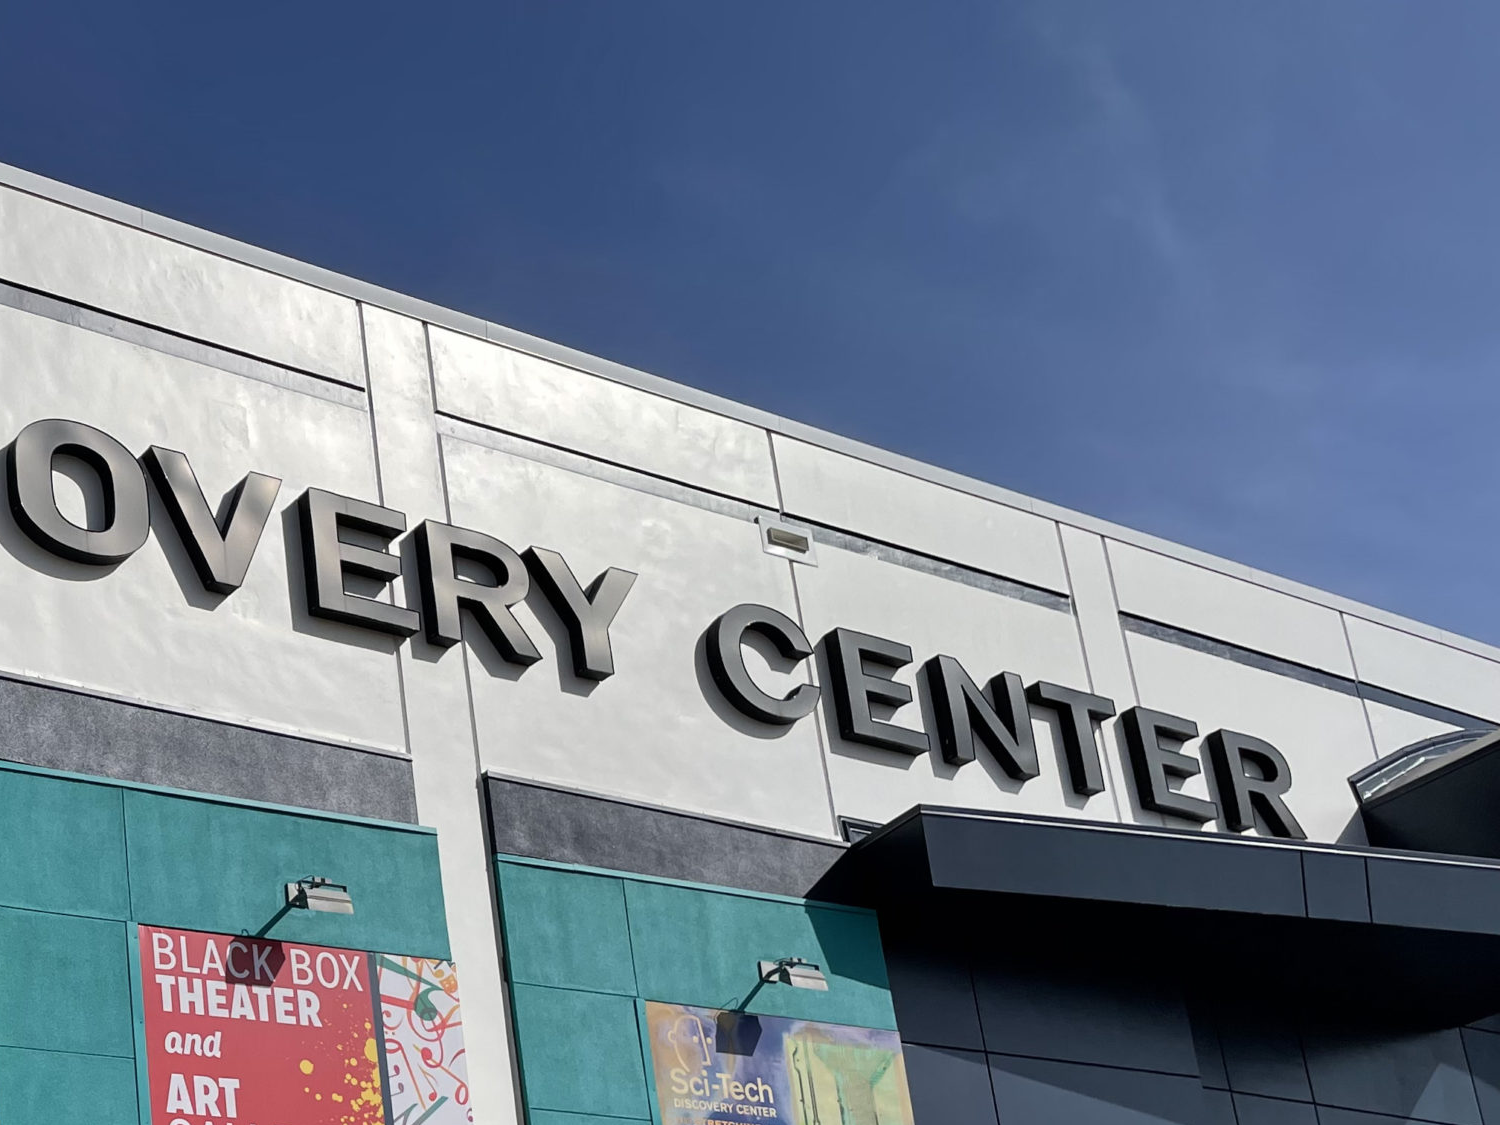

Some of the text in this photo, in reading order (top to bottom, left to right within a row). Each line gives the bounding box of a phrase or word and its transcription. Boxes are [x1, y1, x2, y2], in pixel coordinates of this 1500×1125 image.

[697, 603, 1307, 840] CENTER
[152, 932, 364, 992] BLACK BOX
[155, 974, 323, 1028] THEATER
[164, 1030, 222, 1059] and
[166, 1073, 240, 1119] ART
[669, 1067, 774, 1104] Sci-Tech
[673, 1098, 777, 1118] DISCOVERY CENTER
